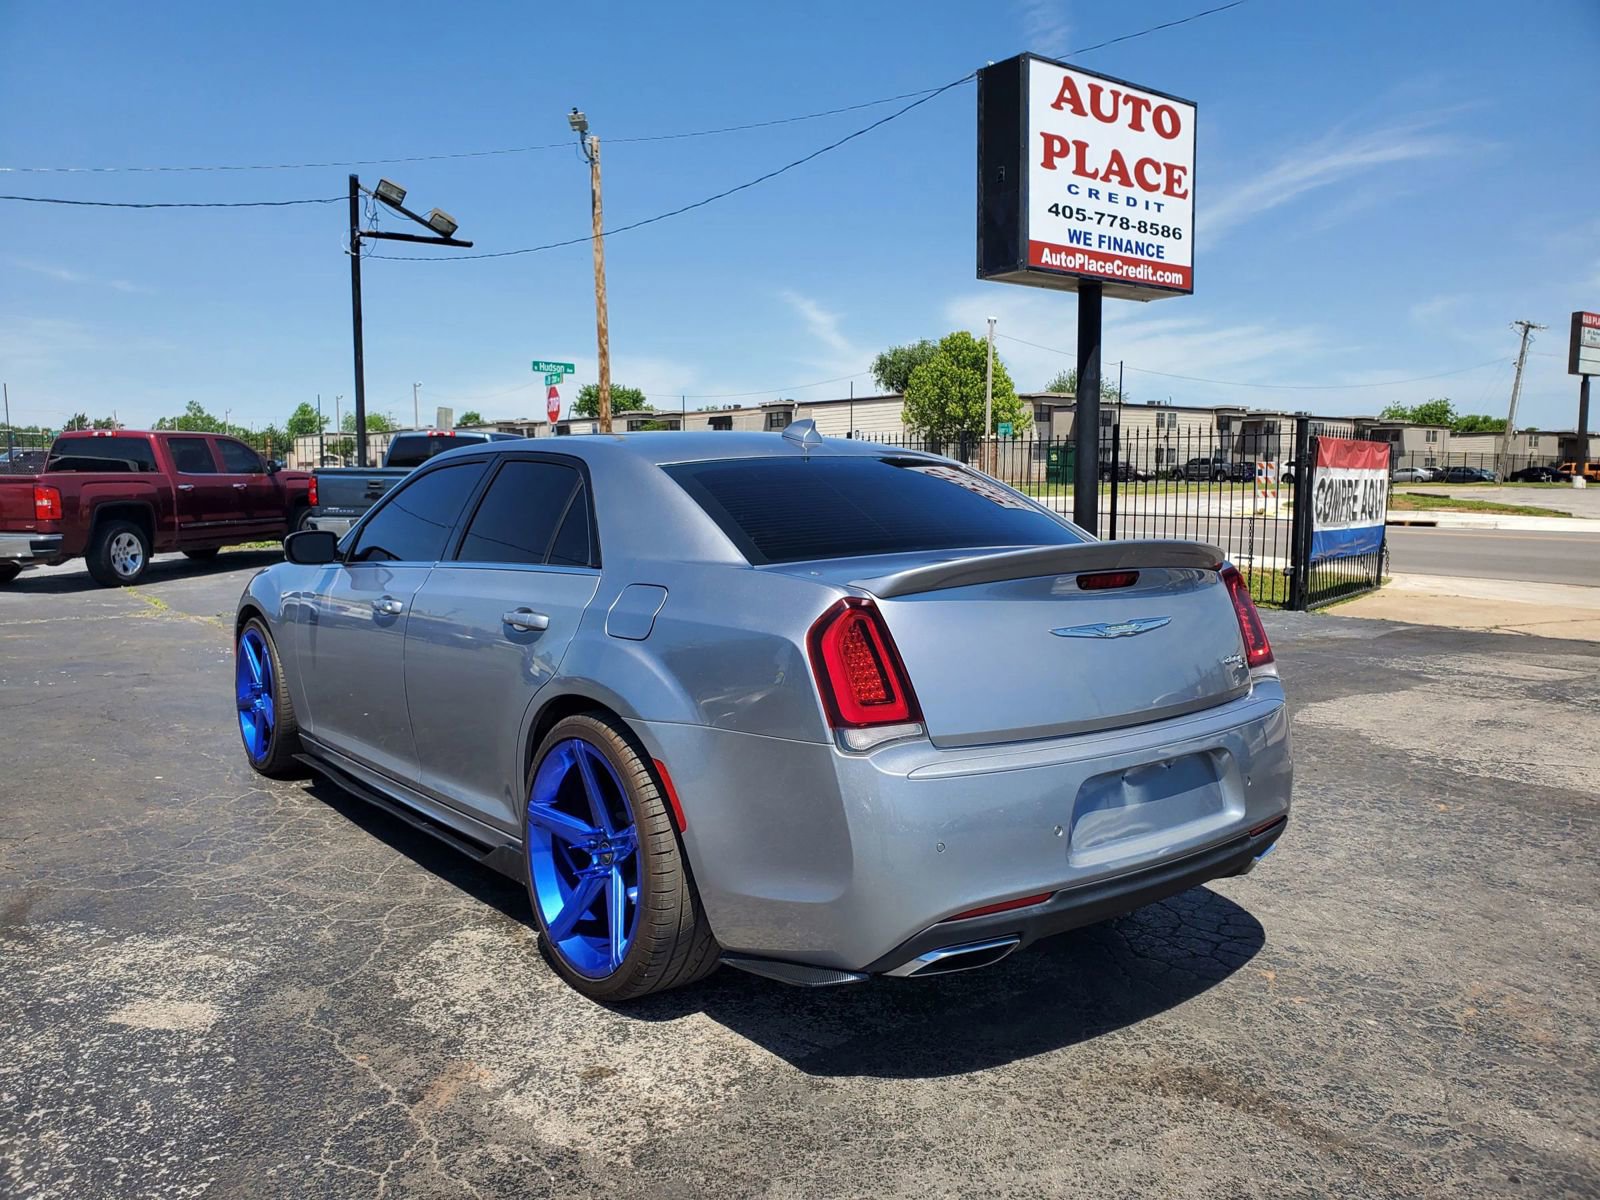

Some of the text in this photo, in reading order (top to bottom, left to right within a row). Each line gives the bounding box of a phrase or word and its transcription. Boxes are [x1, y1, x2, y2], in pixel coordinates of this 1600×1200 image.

[1050, 75, 1181, 140] AUTO
[1039, 131, 1189, 200] PLACE
[1066, 183, 1165, 213] CREDIT
[1047, 202, 1183, 241] 405-778-8586
[1067, 228, 1165, 260] WE FINANCE
[1041, 247, 1184, 286] AutoPlaceCredit.com
[539, 362, 565, 373] Hudson
[1315, 478, 1384, 523] COMPRE AQUI
